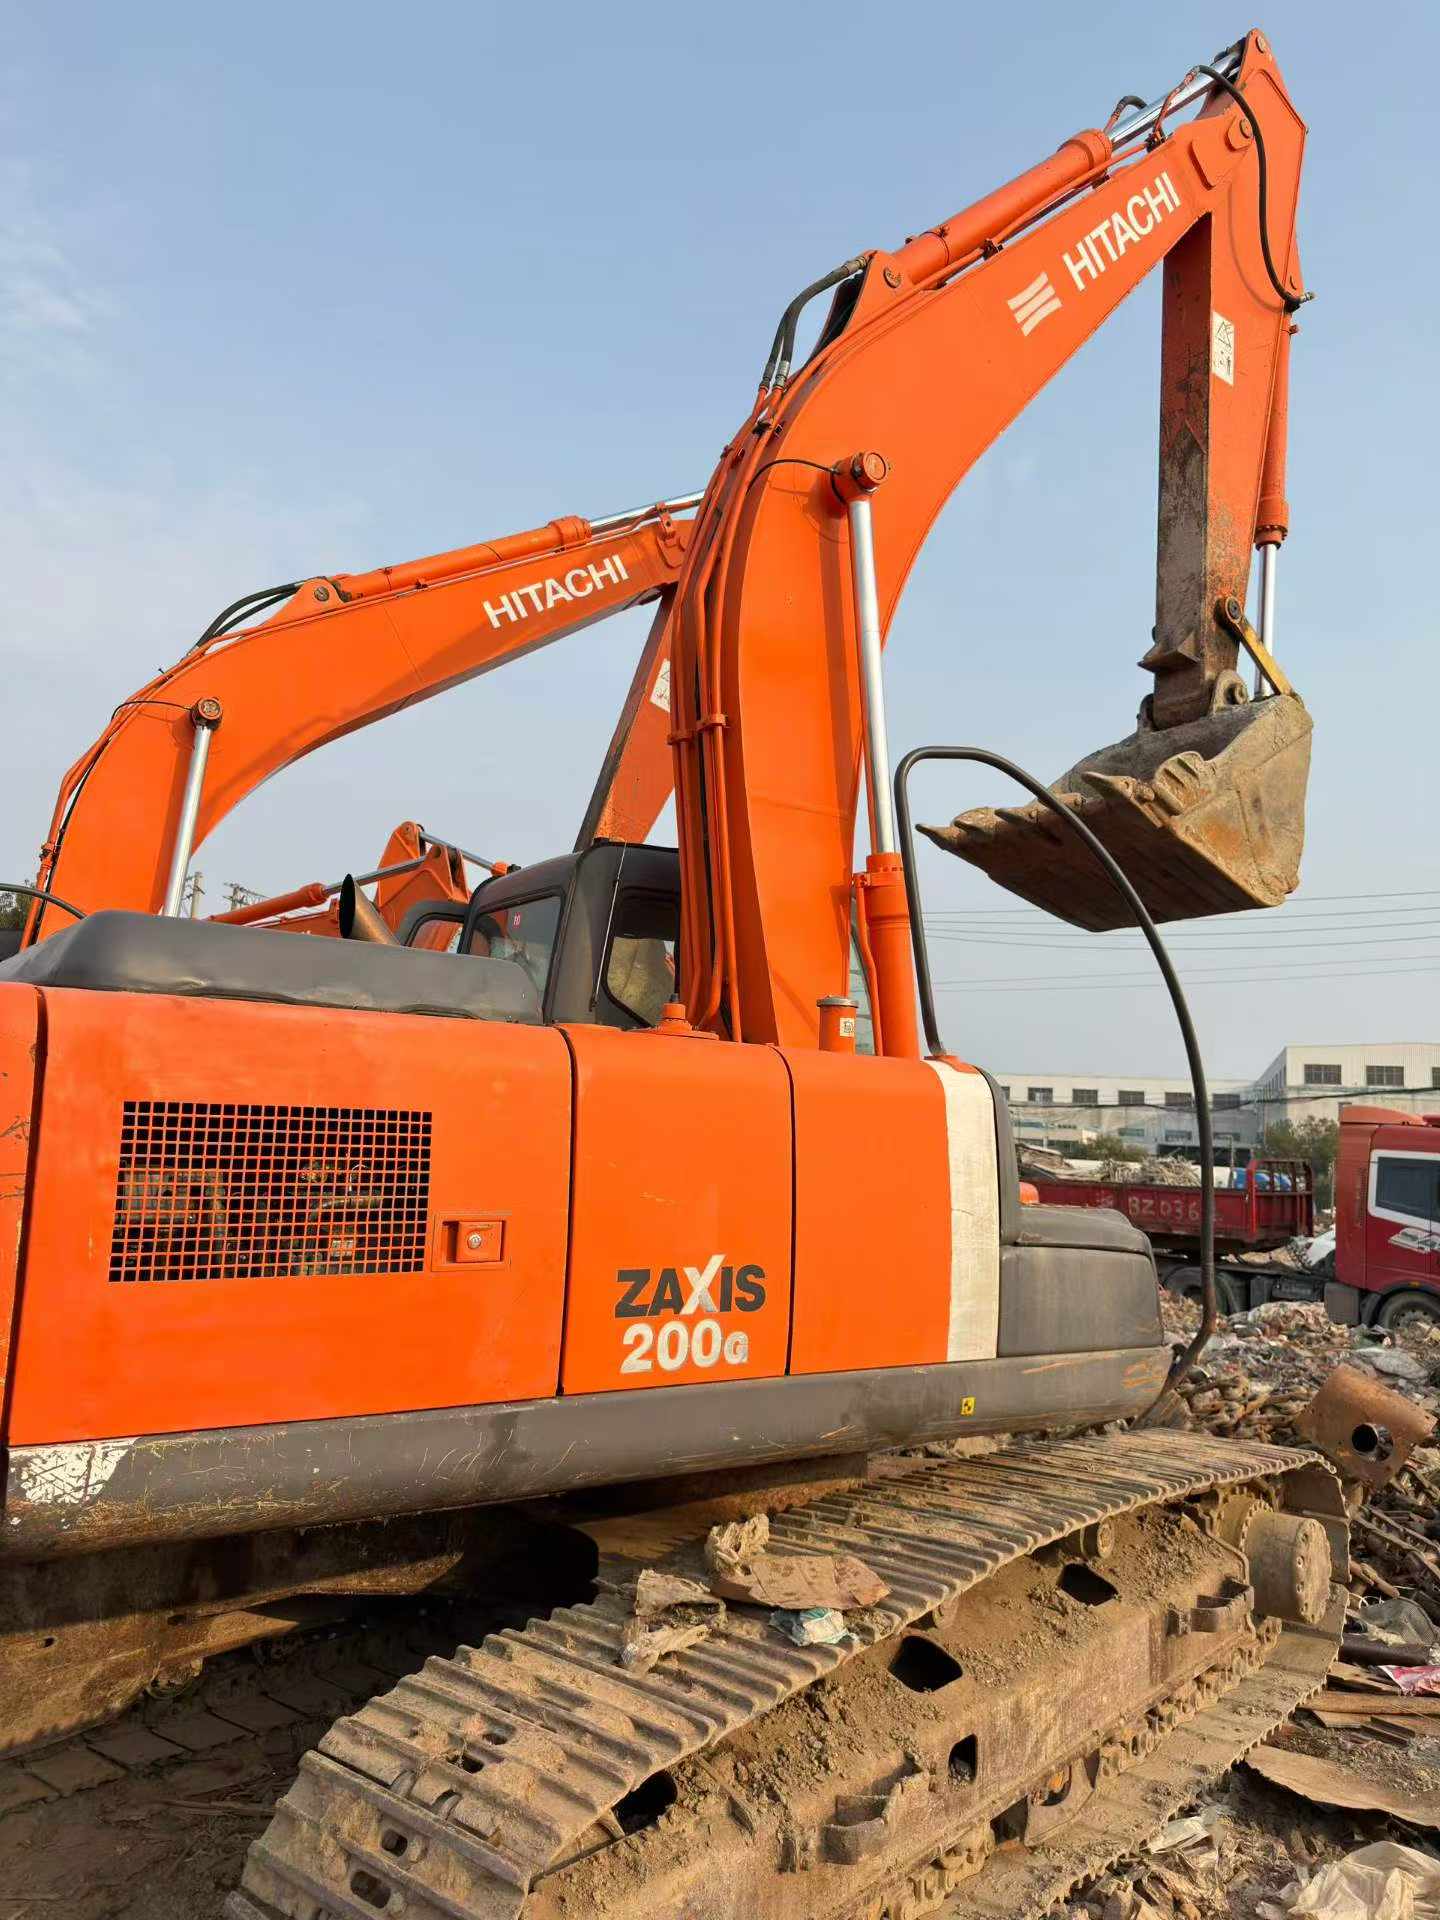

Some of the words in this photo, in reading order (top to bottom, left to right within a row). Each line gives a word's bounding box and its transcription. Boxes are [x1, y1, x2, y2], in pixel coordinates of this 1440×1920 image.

[1062, 171, 1182, 292] HITACHI
[481, 554, 630, 629] HITACHI
[614, 1253, 767, 1319] ZAXIS
[619, 1318, 750, 1374] 200G
